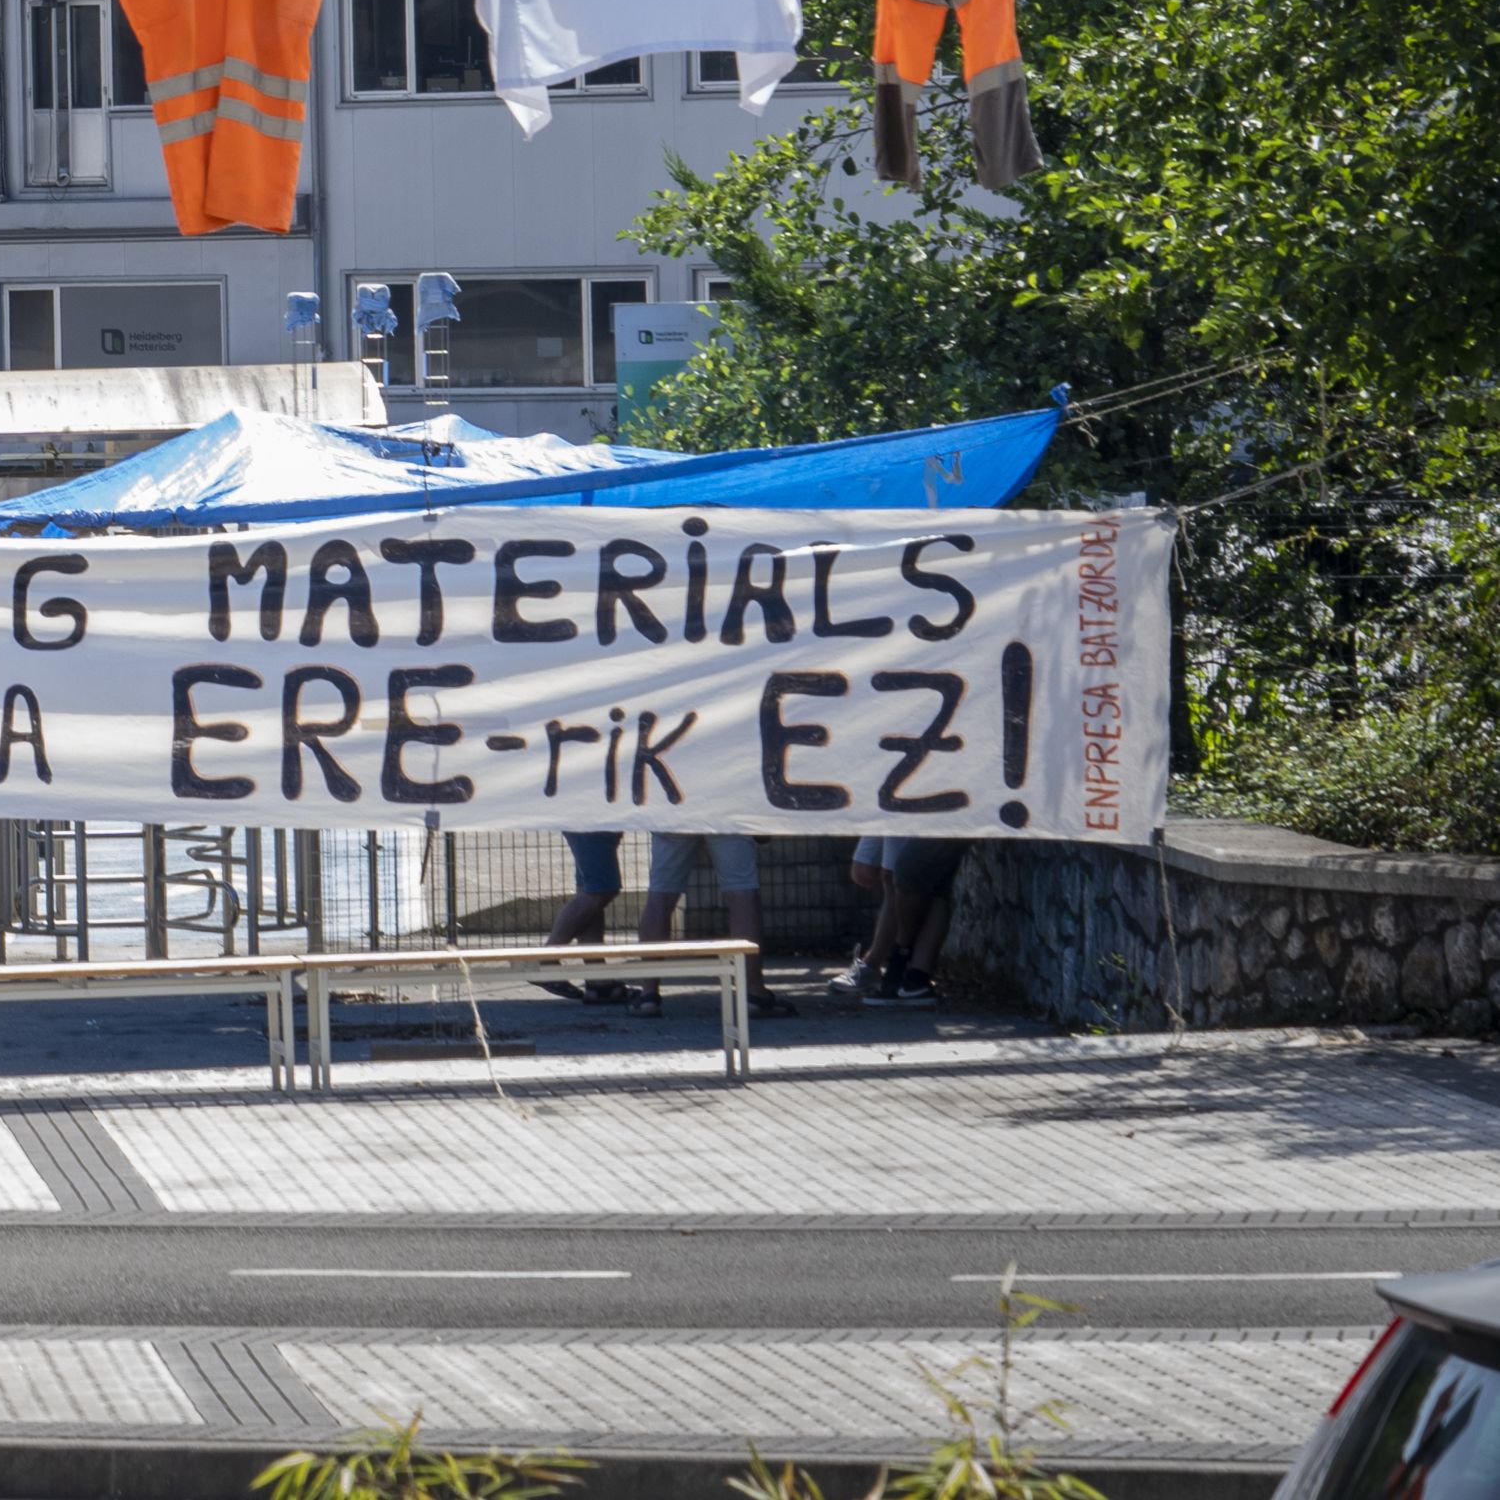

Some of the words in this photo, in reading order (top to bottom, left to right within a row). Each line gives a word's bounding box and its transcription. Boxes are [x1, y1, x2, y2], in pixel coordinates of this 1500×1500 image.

[129, 331, 182, 343] Heidelberg
[129, 343, 177, 351] Materials
[1078, 514, 1122, 669] BATZORDEA
[760, 641, 1033, 830] EZ!
[1084, 682, 1121, 832] ENPRESA
